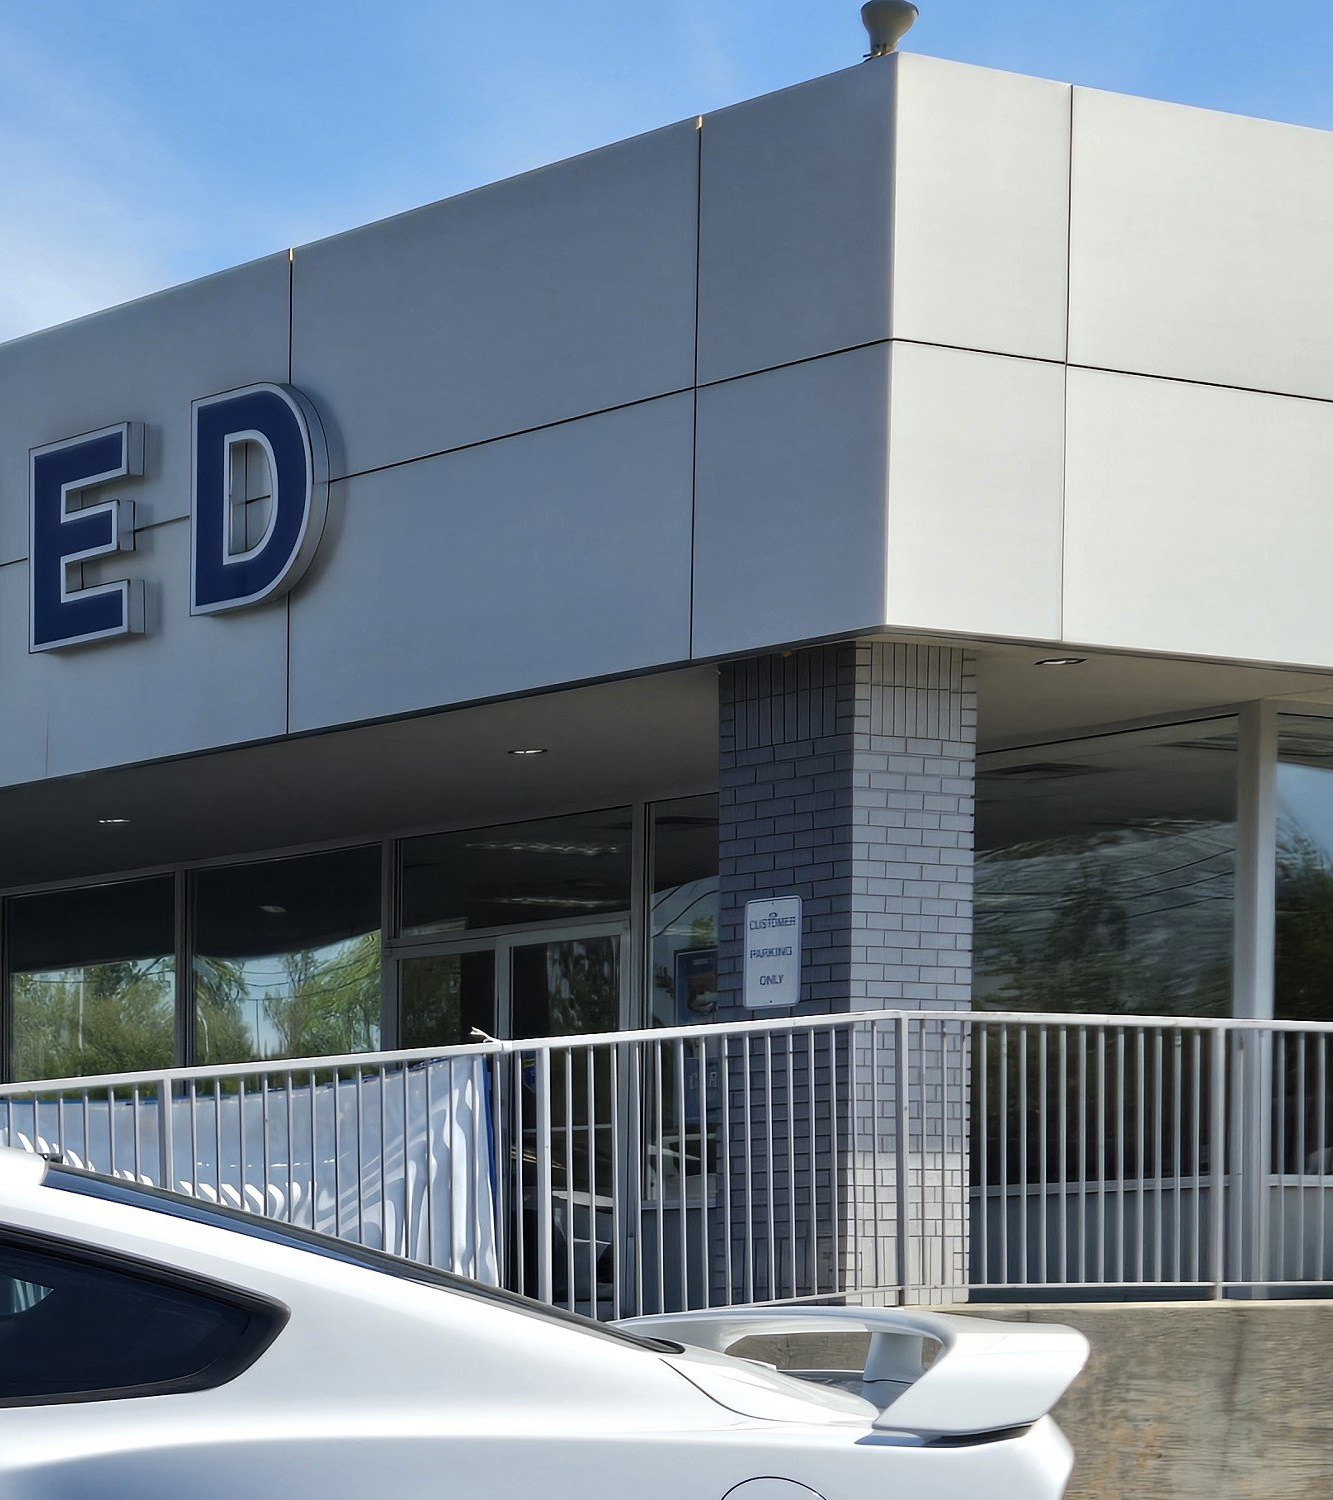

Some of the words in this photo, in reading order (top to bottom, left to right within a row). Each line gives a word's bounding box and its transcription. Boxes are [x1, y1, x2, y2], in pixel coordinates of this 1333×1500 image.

[749, 916, 796, 931] CUSTOMER
[749, 946, 793, 959] PARKING
[759, 974, 784, 986] ONLY
